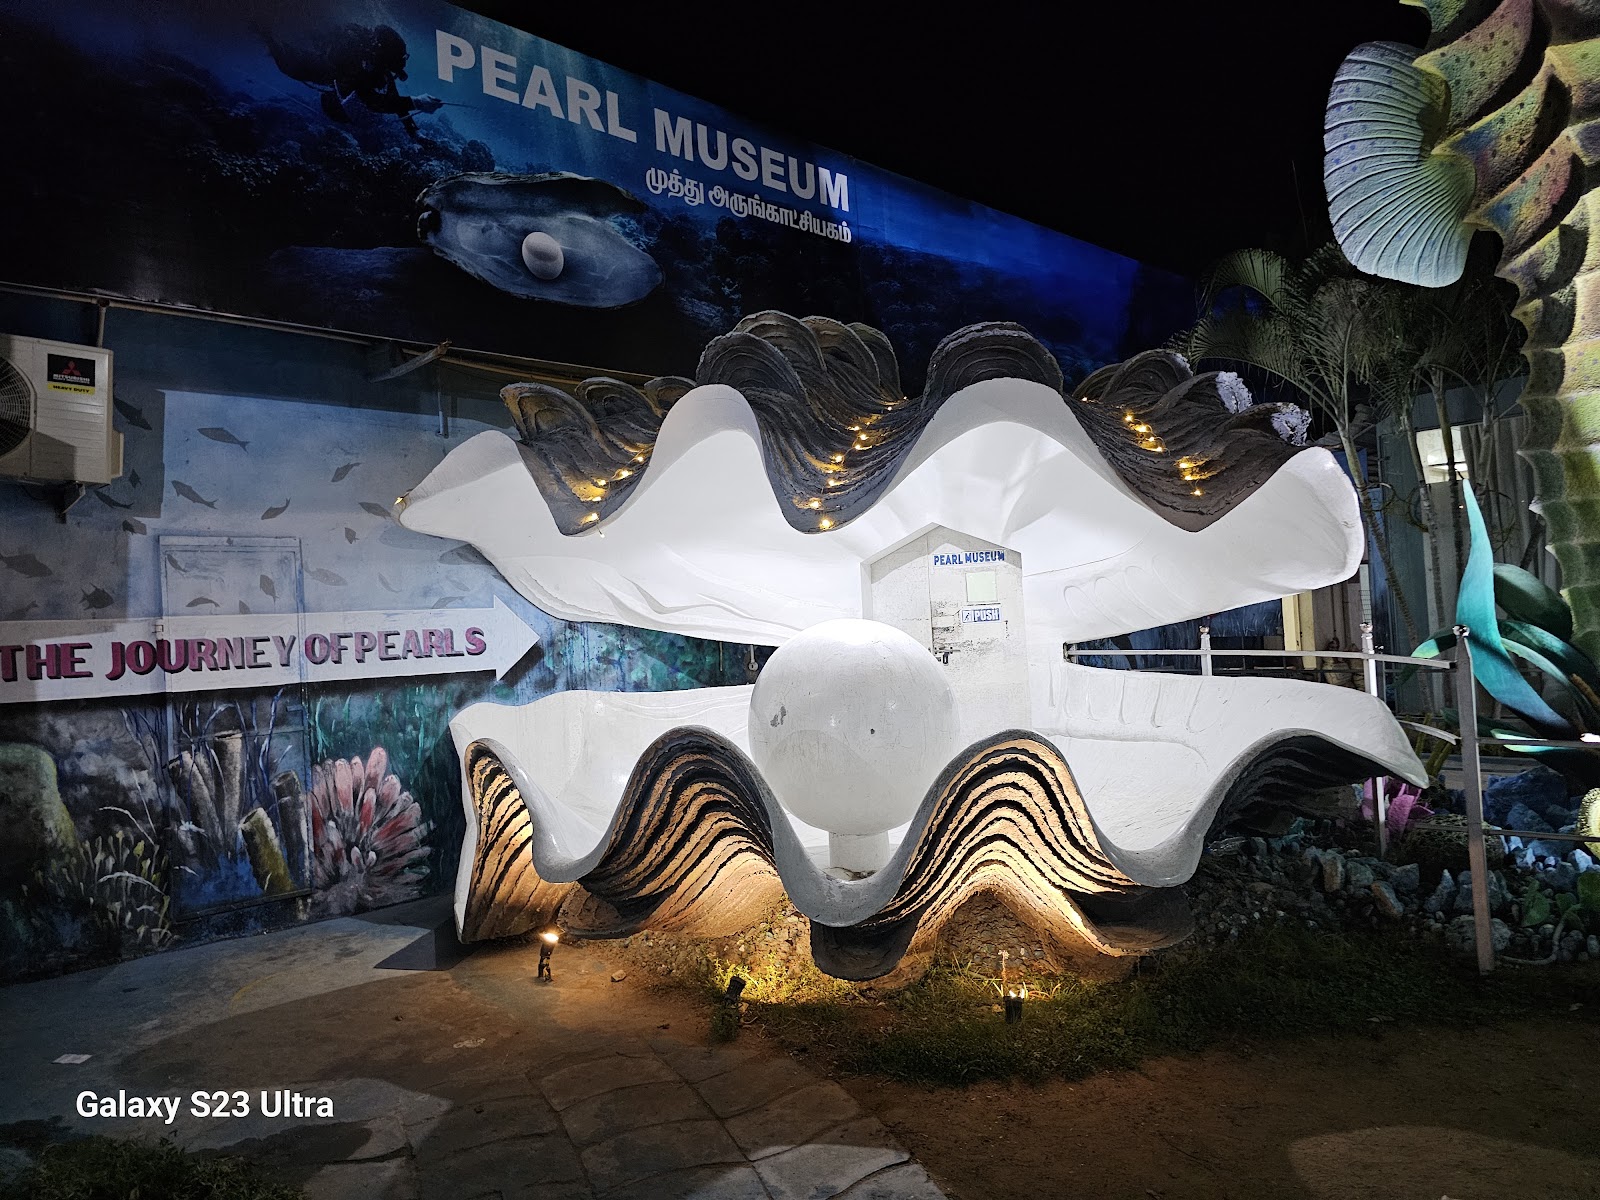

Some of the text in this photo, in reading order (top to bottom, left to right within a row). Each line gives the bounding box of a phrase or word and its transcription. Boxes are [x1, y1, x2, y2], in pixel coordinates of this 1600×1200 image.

[435, 29, 850, 213] PEARL MUSEUM
[645, 167, 705, 206] முத்து
[933, 550, 1005, 565] PEARL MUSEUM
[974, 609, 999, 621] PUSH
[0, 642, 93, 682] THE
[106, 635, 296, 680] JOURNEY
